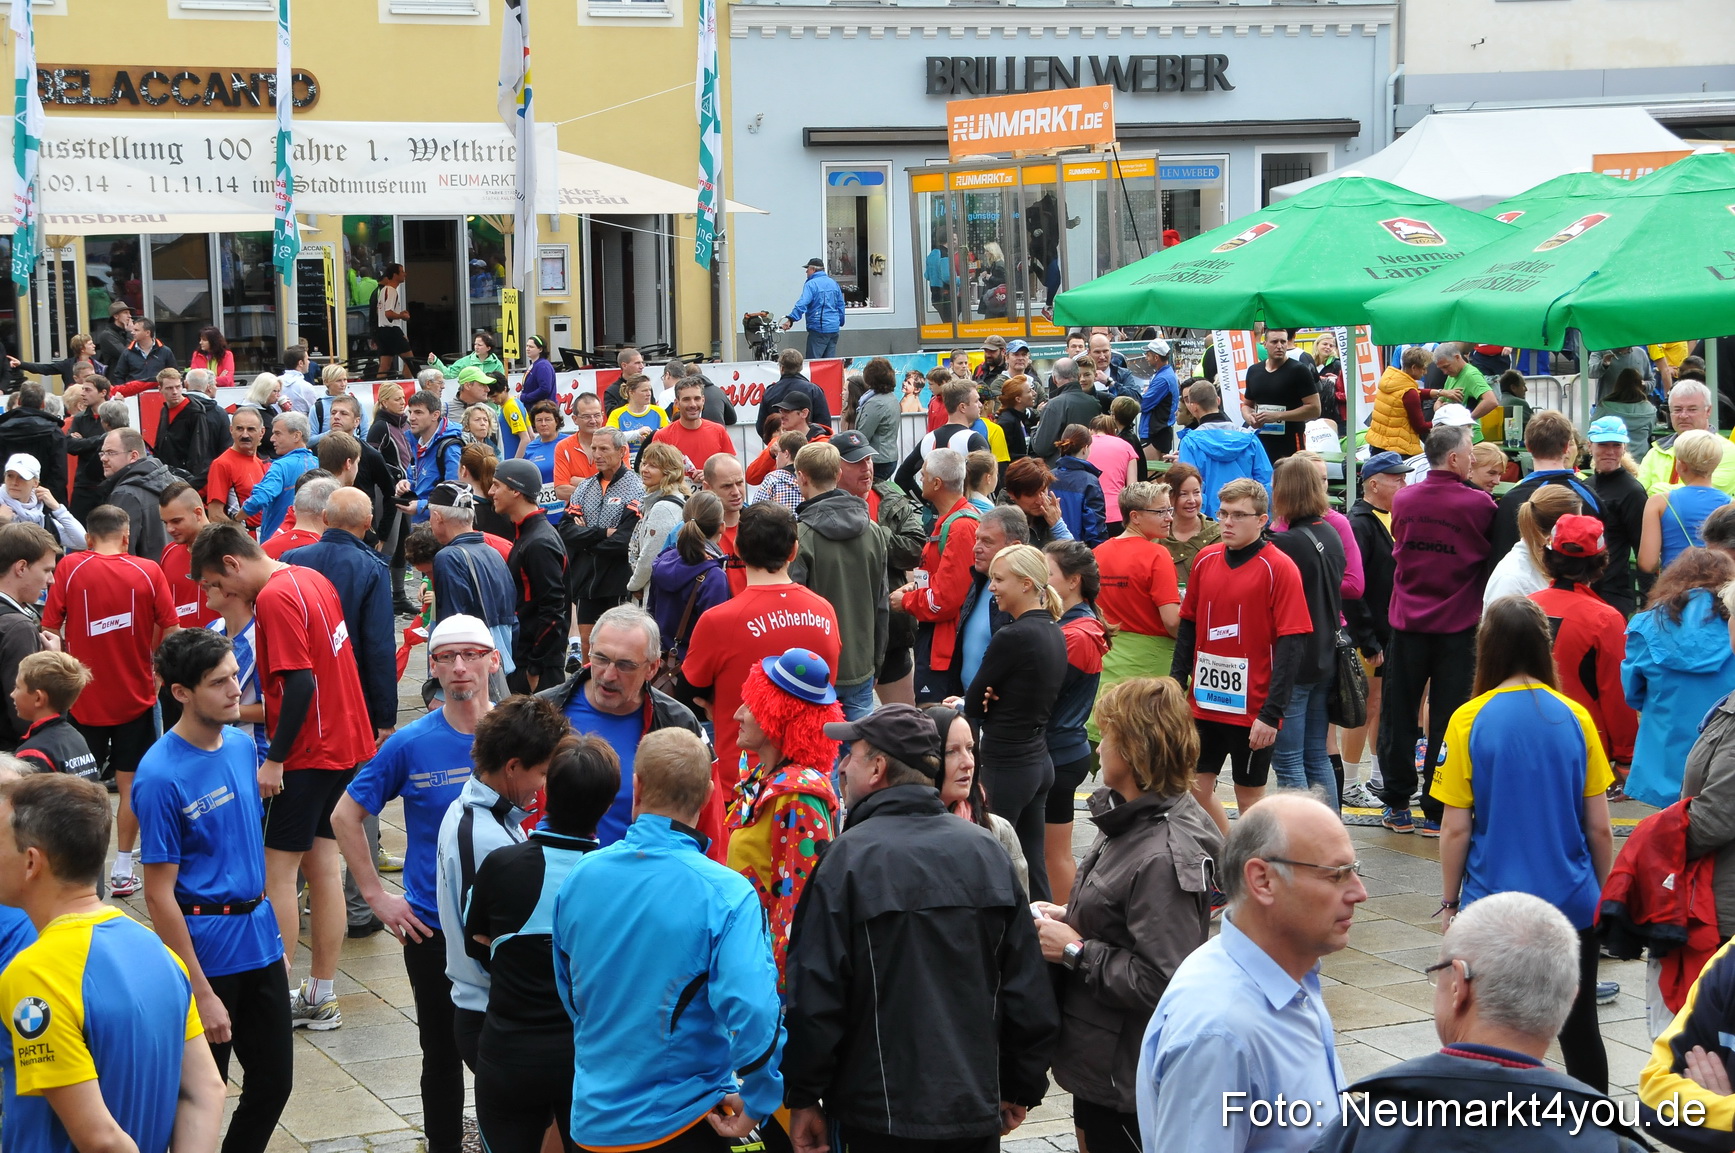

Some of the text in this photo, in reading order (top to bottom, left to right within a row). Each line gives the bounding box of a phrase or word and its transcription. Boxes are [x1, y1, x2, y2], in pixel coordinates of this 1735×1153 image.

[926, 53, 1236, 95] BRILLEN WEBER
[12, 135, 184, 165] usstellung
[204, 137, 252, 161] 100
[368, 139, 389, 162] 1.
[438, 173, 517, 187] NEUMARKT
[1182, 167, 1215, 178] WEBER
[150, 175, 239, 194] 11.11.14
[252, 175, 276, 194] im
[293, 174, 427, 195] Stadtmuseum
[503, 291, 516, 304] Block
[506, 310, 516, 343] A
[102, 618, 120, 630] DEHN
[747, 608, 831, 638] SV Höhenberg
[1216, 628, 1230, 637] DEHN
[1212, 660, 1237, 669] Neumarkt
[1200, 666, 1242, 692] 2698
[1207, 692, 1232, 705] Manuel
[18, 1042, 55, 1059] PARTL
